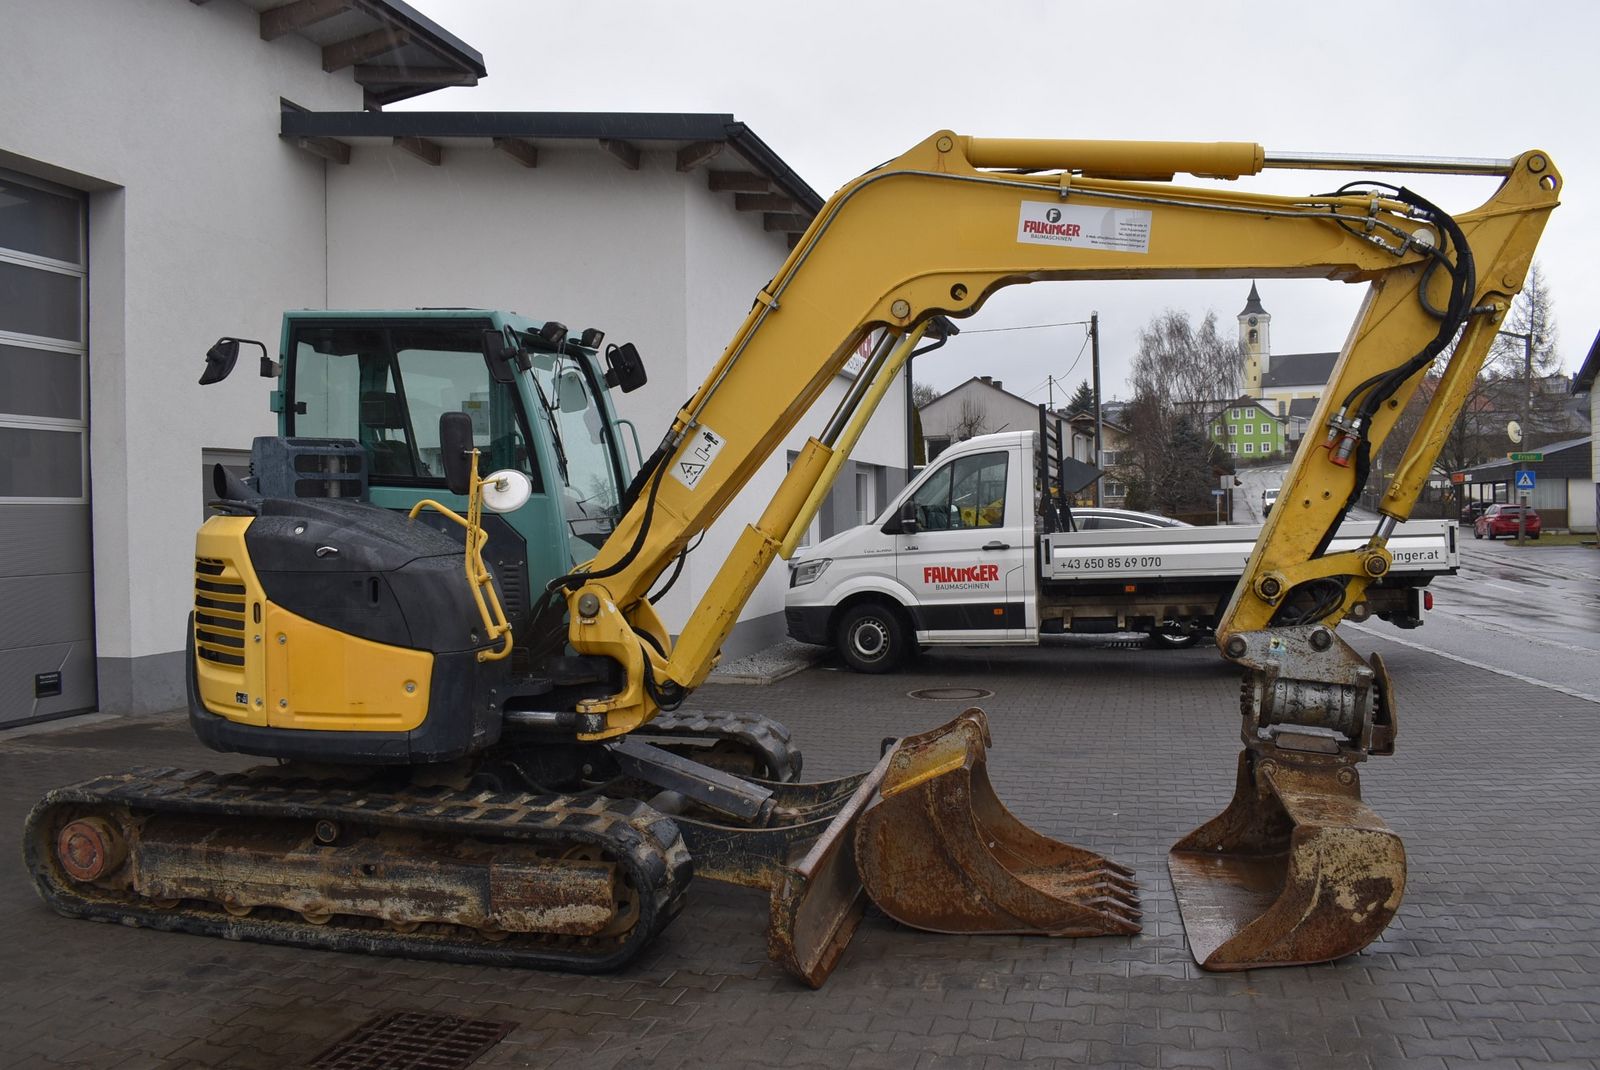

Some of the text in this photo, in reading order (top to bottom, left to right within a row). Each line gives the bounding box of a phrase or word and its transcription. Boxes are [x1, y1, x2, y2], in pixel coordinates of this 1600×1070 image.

[1023, 220, 1081, 237] FALKINGER
[1030, 234, 1073, 242] BAUMASCHINEN
[1393, 549, 1439, 563] inger.at
[1060, 557, 1162, 569] +43 650 85 69 070
[923, 565, 999, 584] FALKINGER
[935, 582, 990, 591] BAUMASCHINEN
